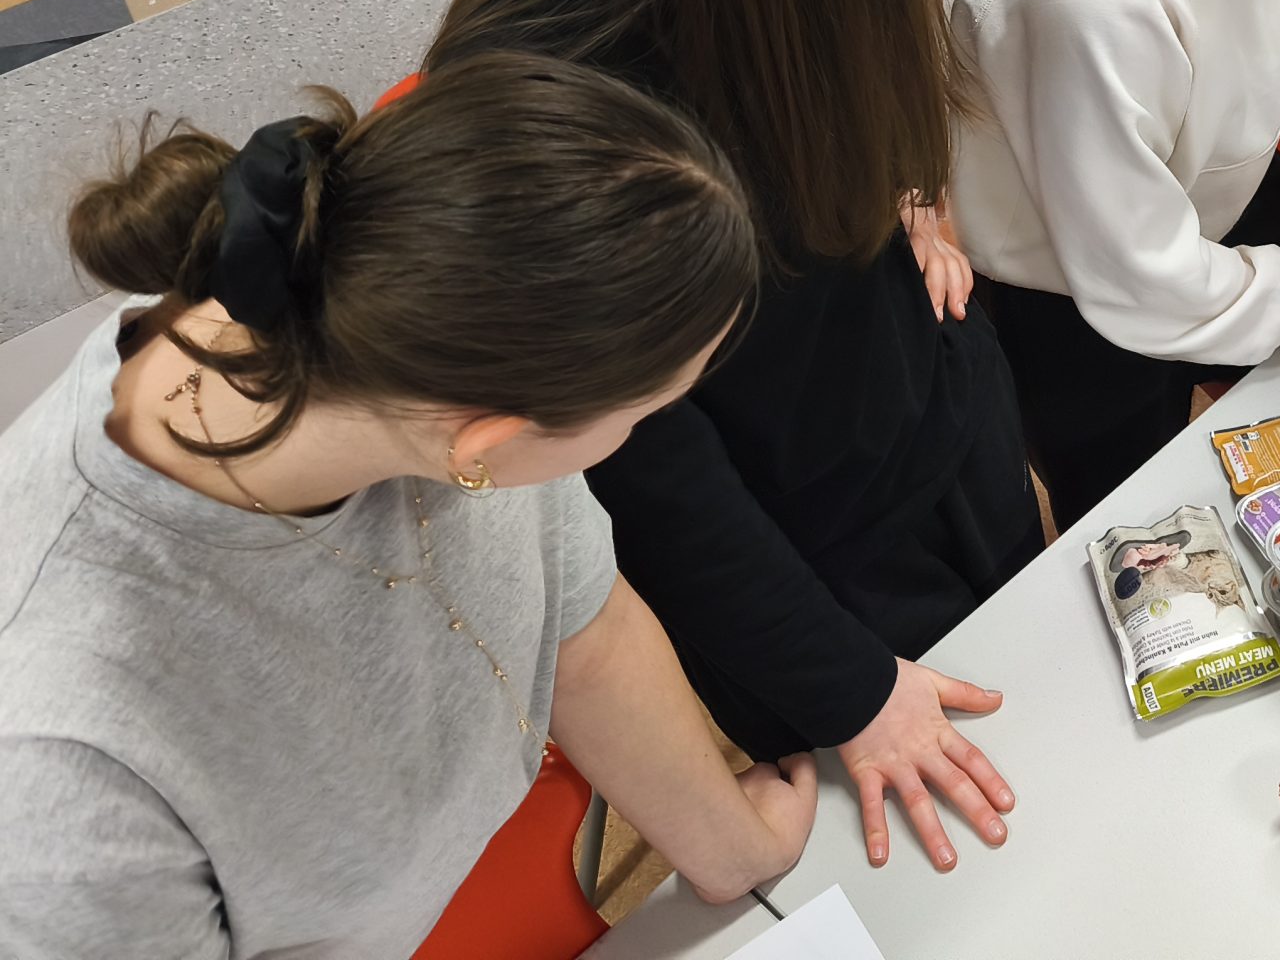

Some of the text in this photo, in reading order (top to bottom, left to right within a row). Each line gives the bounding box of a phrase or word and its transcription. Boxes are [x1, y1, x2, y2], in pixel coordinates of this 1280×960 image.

[1189, 636, 1201, 644] mit
[1201, 630, 1218, 639] Huhn
[1196, 645, 1274, 678] MEAT MENU
[1143, 686, 1160, 711] ADULT
